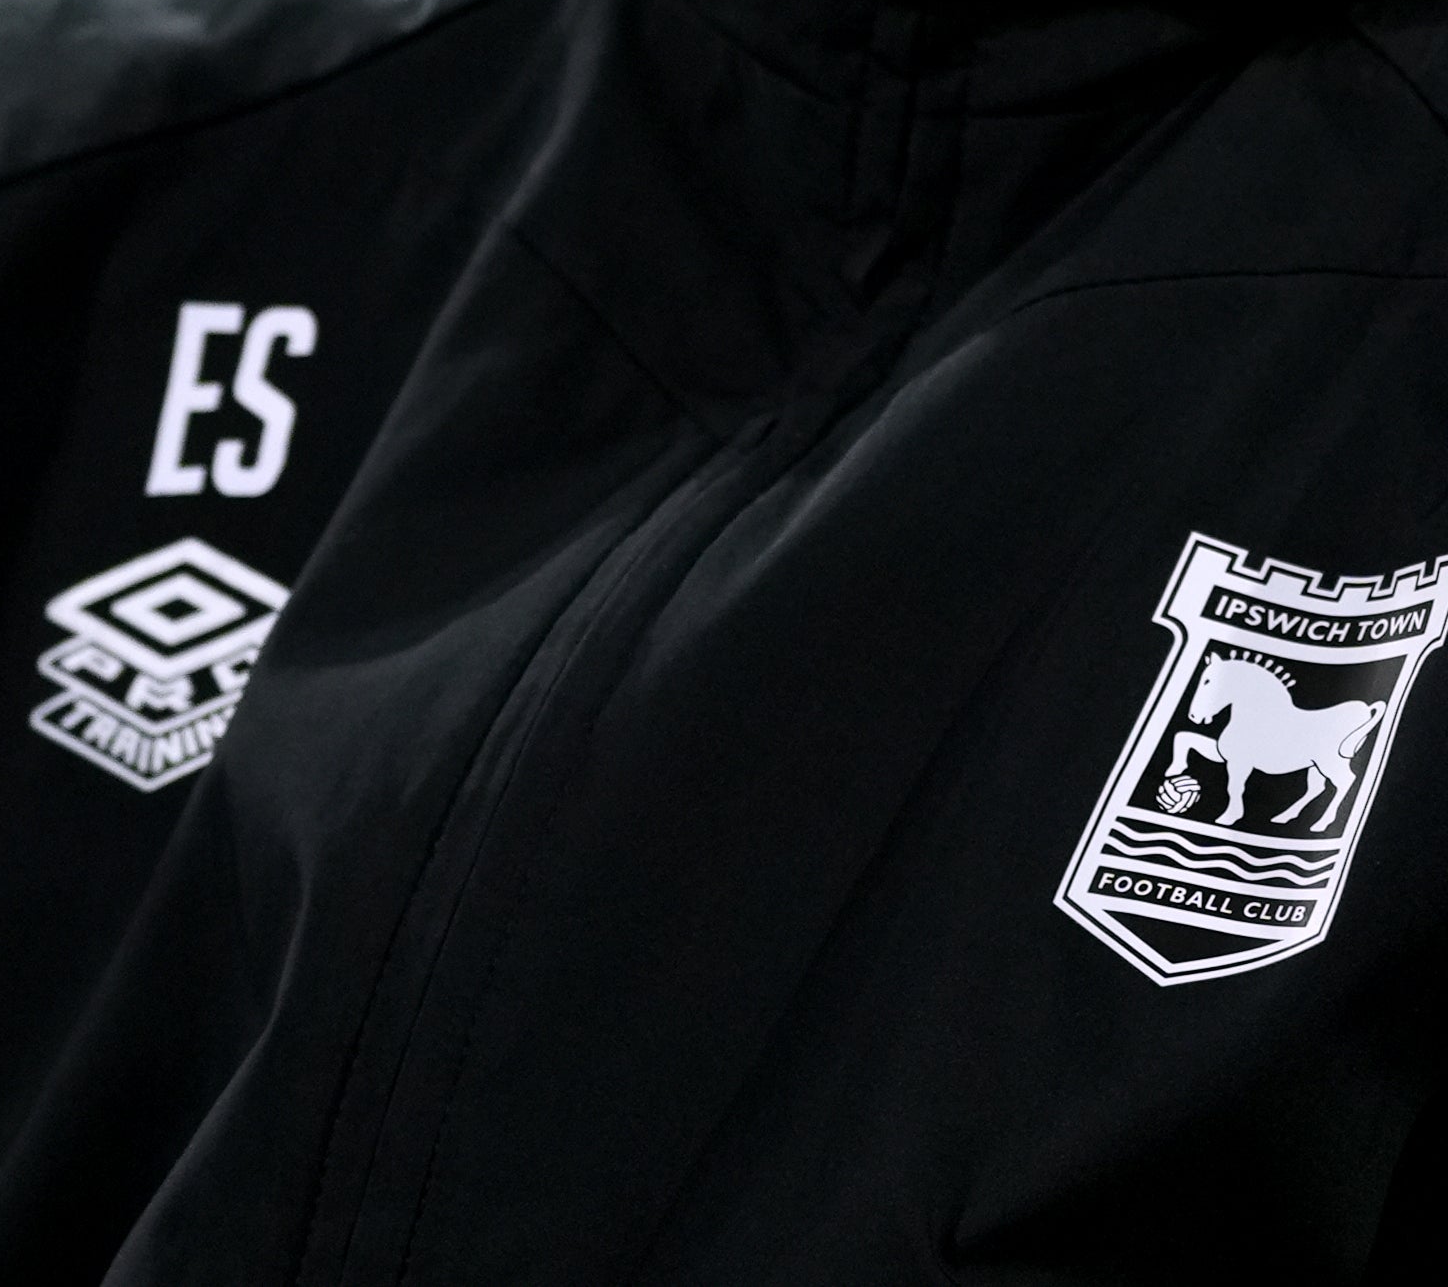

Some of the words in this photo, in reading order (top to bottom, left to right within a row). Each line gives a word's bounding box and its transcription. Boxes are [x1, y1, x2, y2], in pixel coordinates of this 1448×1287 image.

[145, 301, 318, 498] ES
[1214, 594, 1351, 643] IPSWICH
[1356, 608, 1426, 641] TOWN
[59, 699, 236, 773] TRAININ
[1097, 872, 1233, 914] FOOTBALL
[1243, 901, 1306, 922] CLUB
